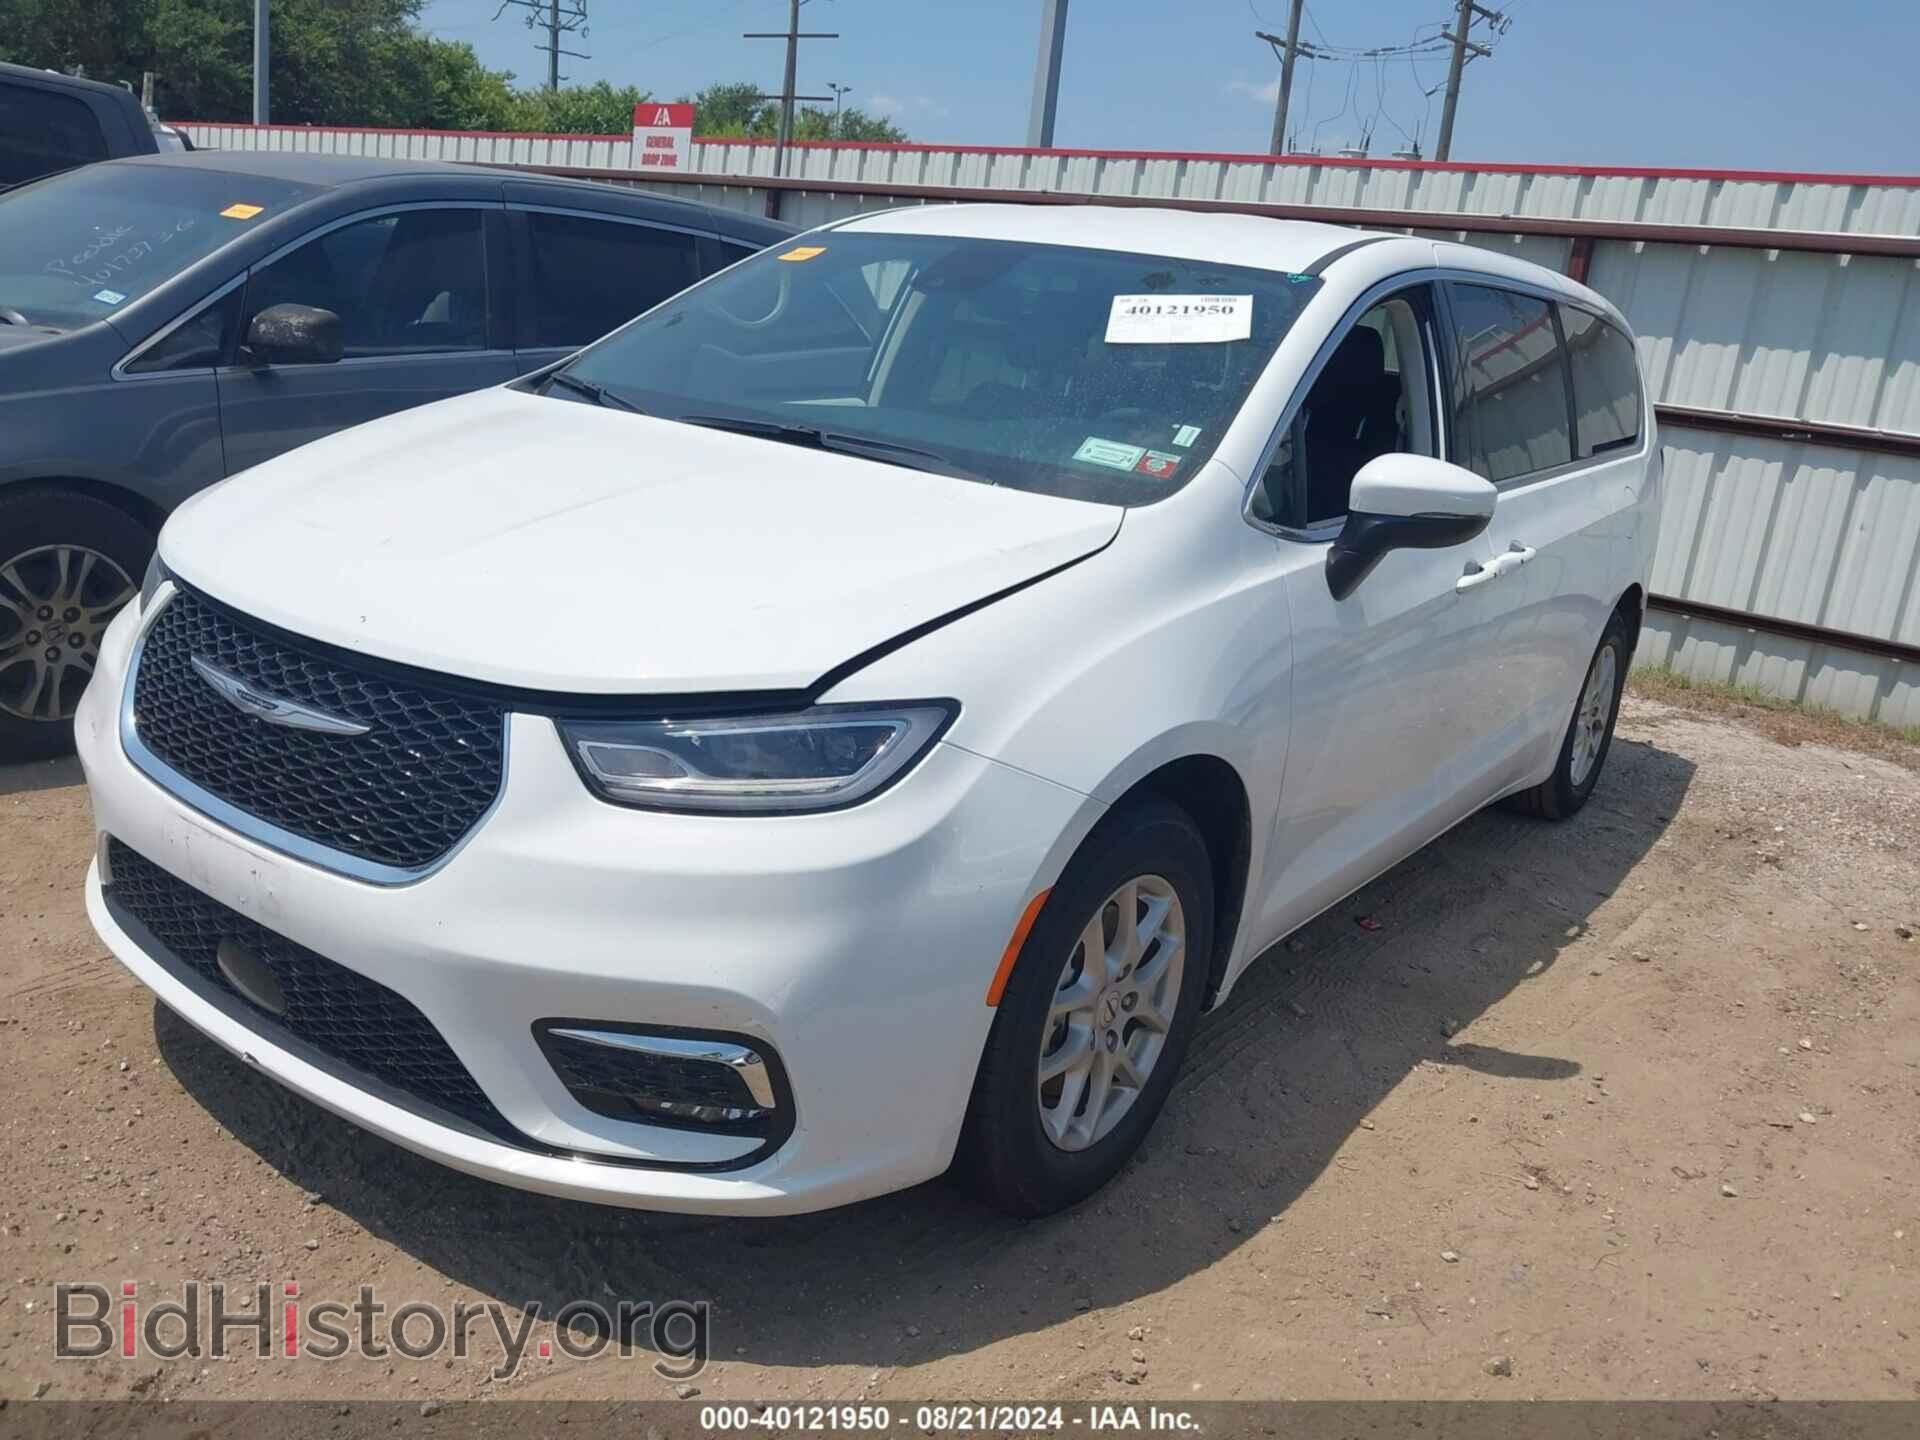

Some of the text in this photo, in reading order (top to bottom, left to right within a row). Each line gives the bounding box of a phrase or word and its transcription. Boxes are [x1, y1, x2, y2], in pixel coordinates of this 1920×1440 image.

[646, 136, 674, 148] GENERAL
[660, 154, 677, 167] ZONE
[1125, 304, 1235, 316] 40121950
